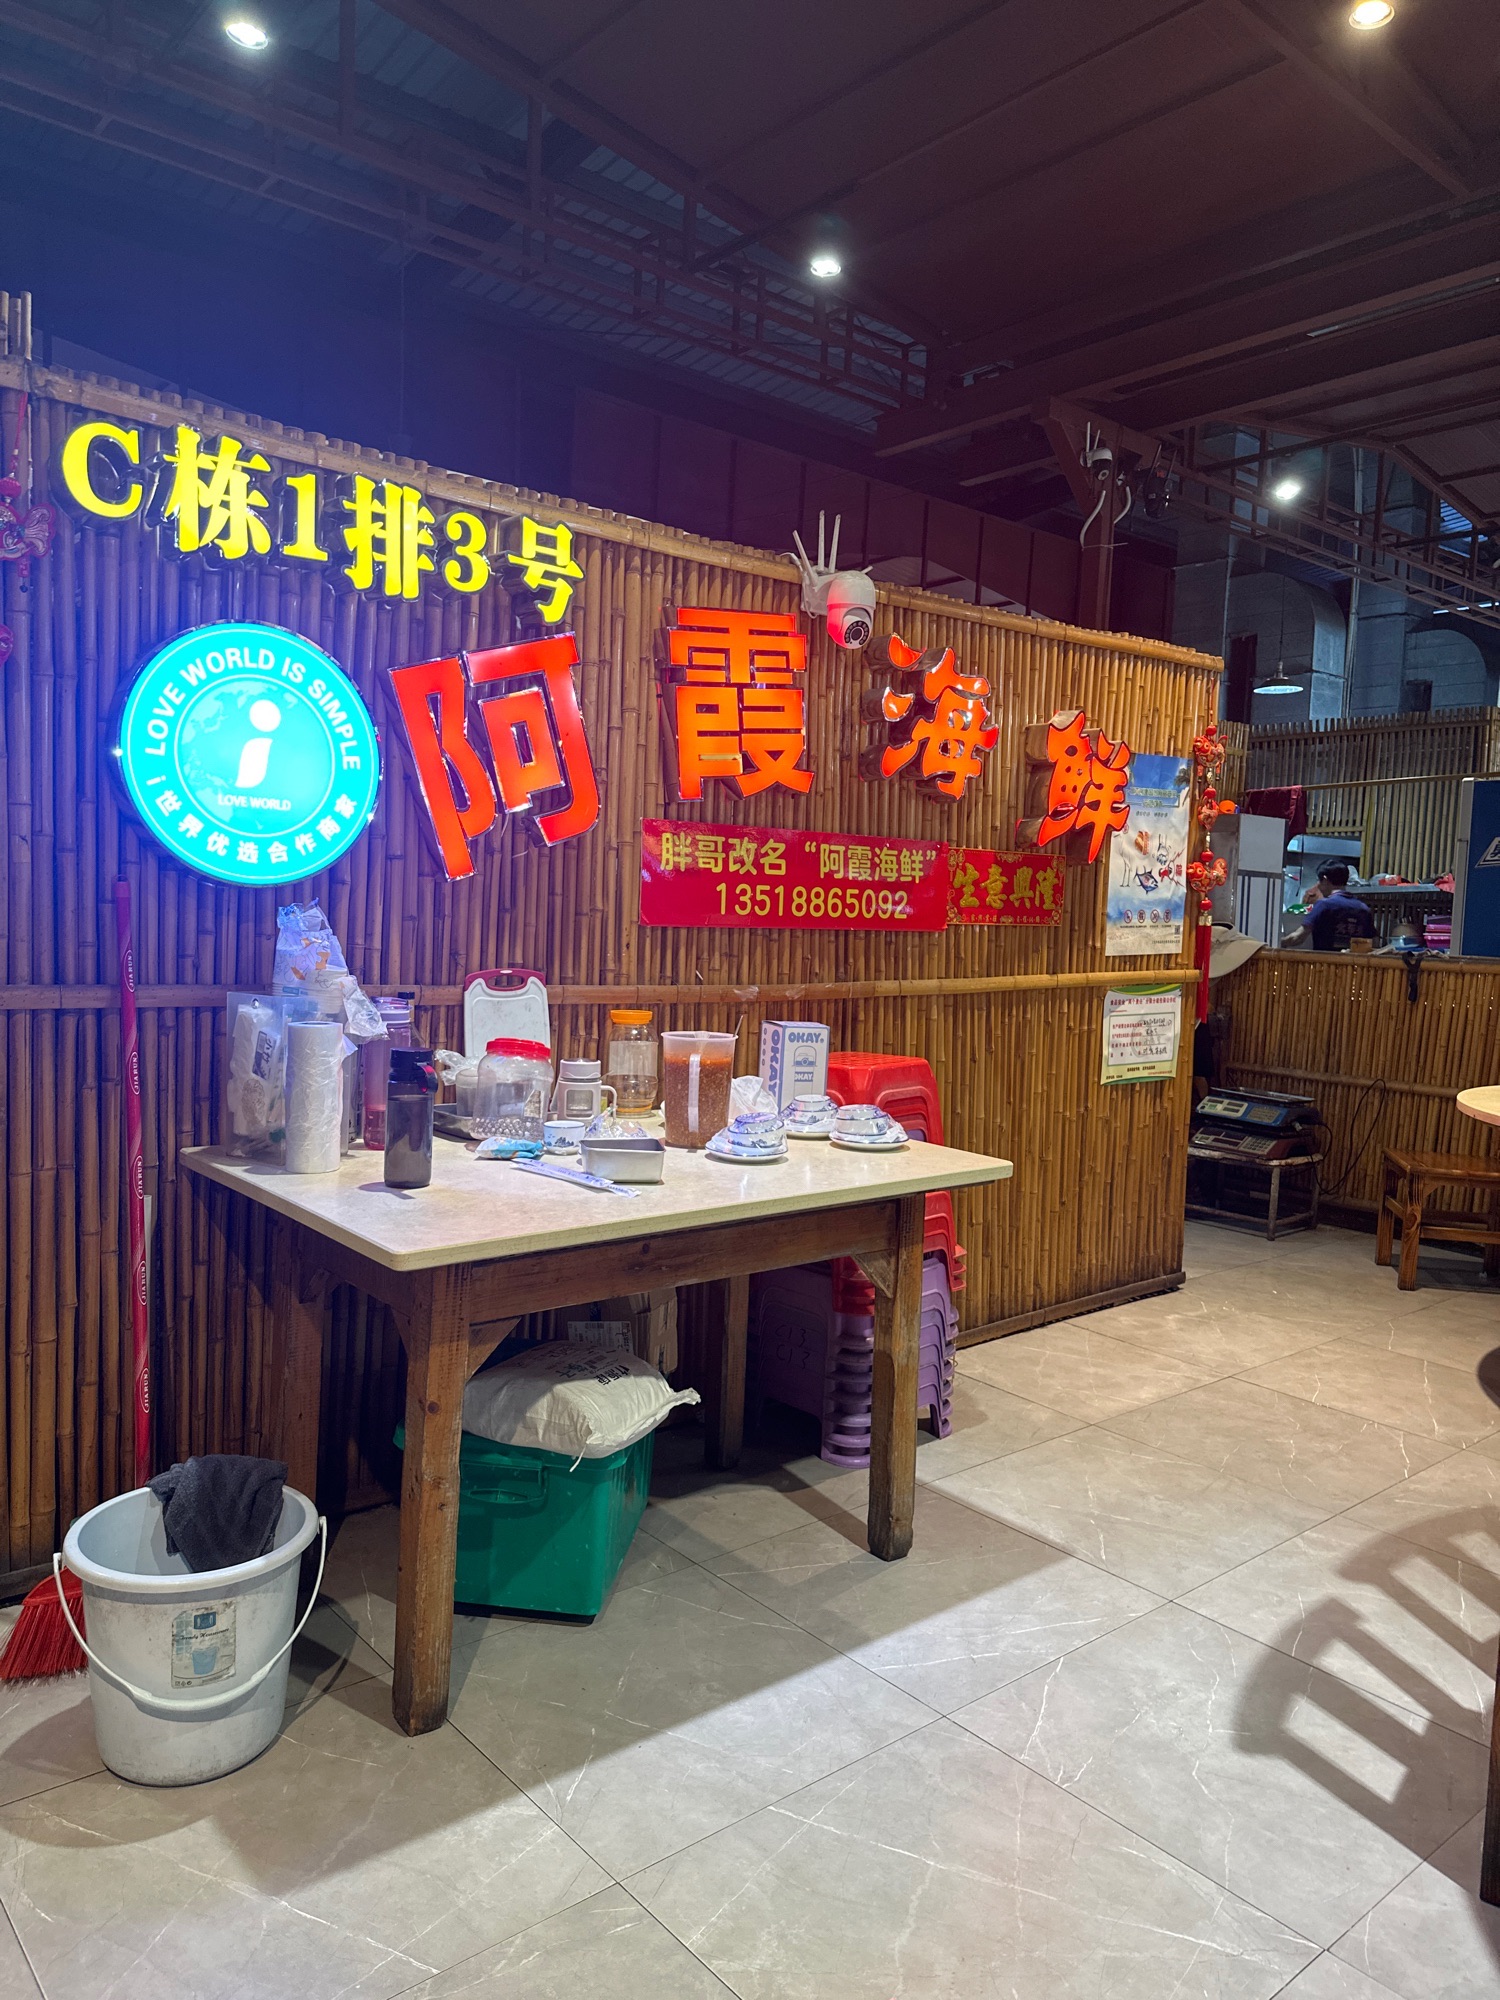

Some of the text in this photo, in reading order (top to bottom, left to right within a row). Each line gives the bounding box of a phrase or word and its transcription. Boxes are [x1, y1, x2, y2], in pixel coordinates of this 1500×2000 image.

[61, 421, 585, 625] C栋1排3号
[145, 646, 361, 771] LOVE WORLD IS SIMPLE
[389, 606, 1131, 880] 阿霞海鲜
[217, 794, 292, 811] LOVE WORLD
[716, 882, 908, 920] 13518865092
[768, 1029, 781, 1098] OKAY
